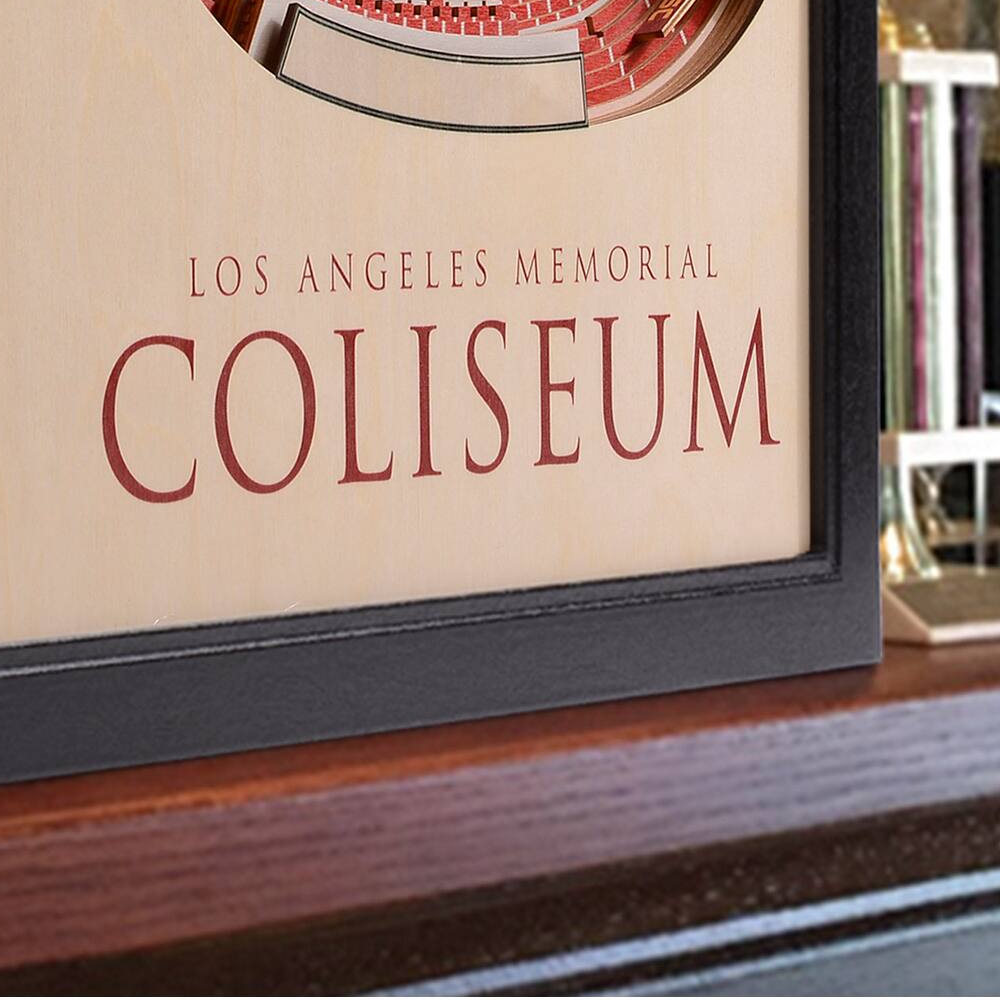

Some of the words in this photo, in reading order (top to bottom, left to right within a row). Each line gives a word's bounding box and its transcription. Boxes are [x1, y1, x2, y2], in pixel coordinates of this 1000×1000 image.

[189, 254, 268, 298] LOS
[297, 248, 488, 294] ANGELES
[515, 243, 719, 286] MEMORIAL
[101, 306, 781, 504] COLISEUM
